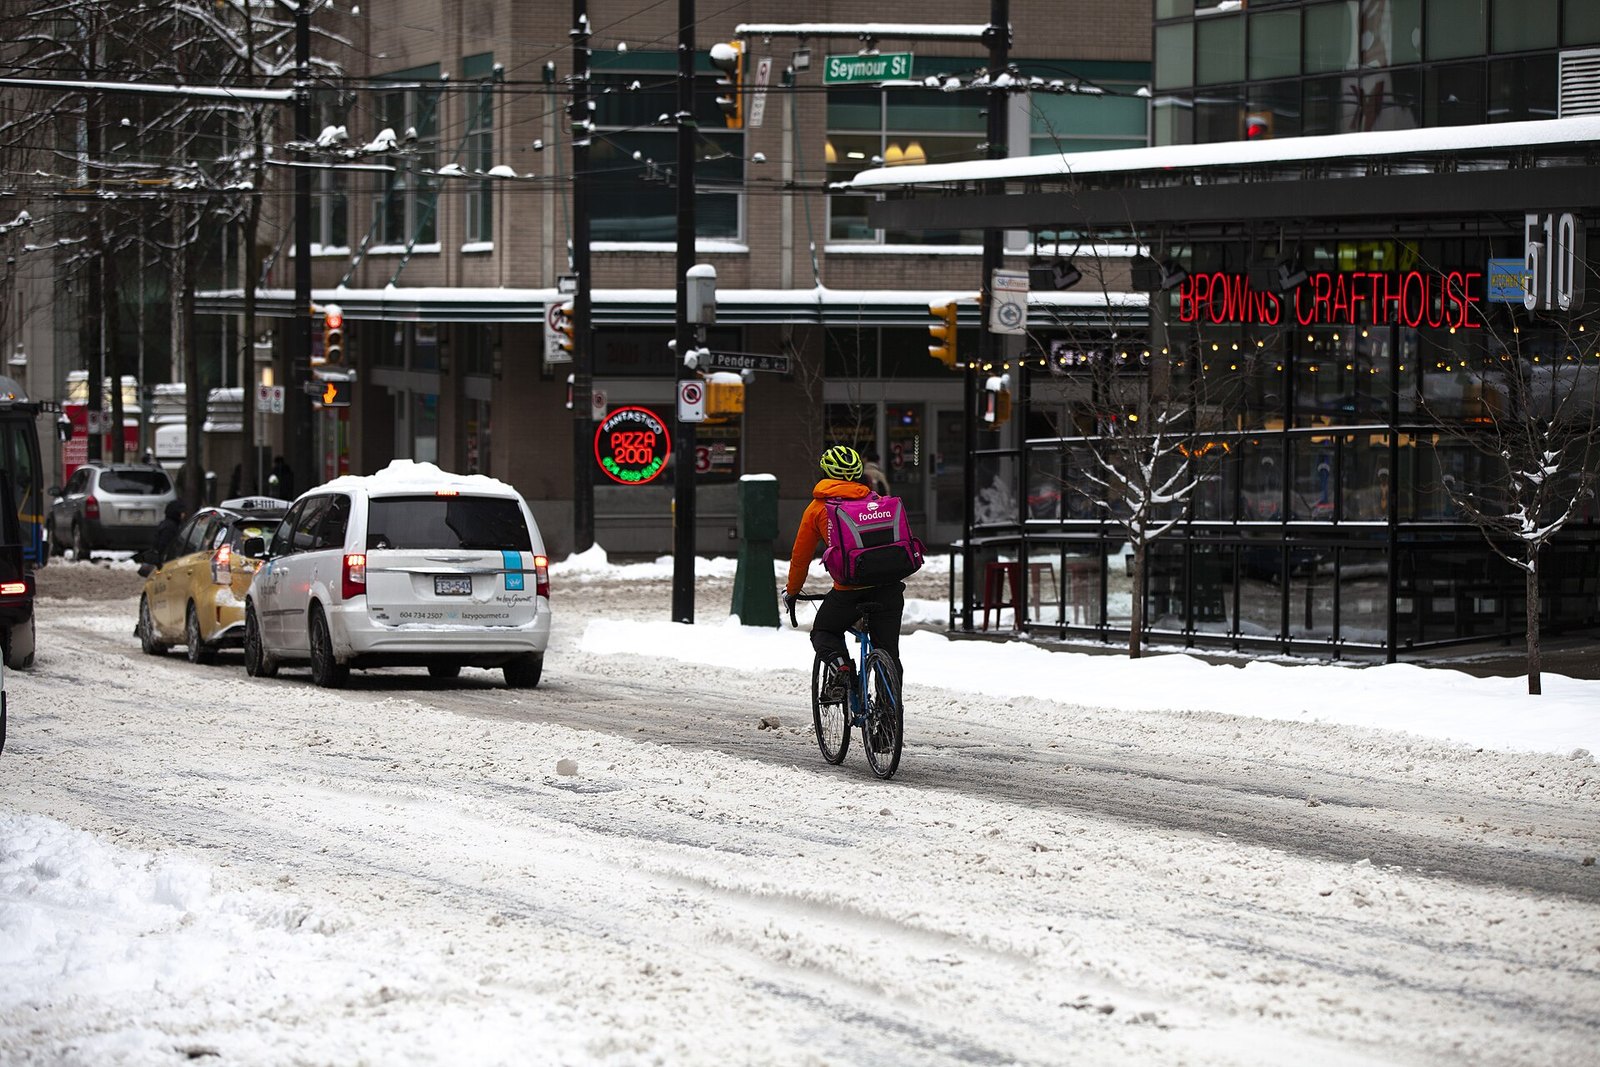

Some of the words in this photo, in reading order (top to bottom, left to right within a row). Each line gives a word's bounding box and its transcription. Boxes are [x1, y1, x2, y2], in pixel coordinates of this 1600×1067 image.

[830, 57, 887, 80] Seymour
[891, 58, 907, 75] St
[1523, 213, 1576, 312] 510
[1179, 271, 1280, 326] BROWNS
[1296, 271, 1481, 328] CRAFTHOUSE
[718, 354, 755, 367] Pender
[603, 411, 662, 434] FANTASTICO
[611, 432, 656, 448] PIZZA
[614, 447, 653, 464] 2001
[859, 511, 891, 521] foodora
[400, 611, 412, 619] 604
[414, 611, 426, 619] 734
[427, 612, 443, 620] 2507
[461, 612, 510, 621] lazygourmet.ca
